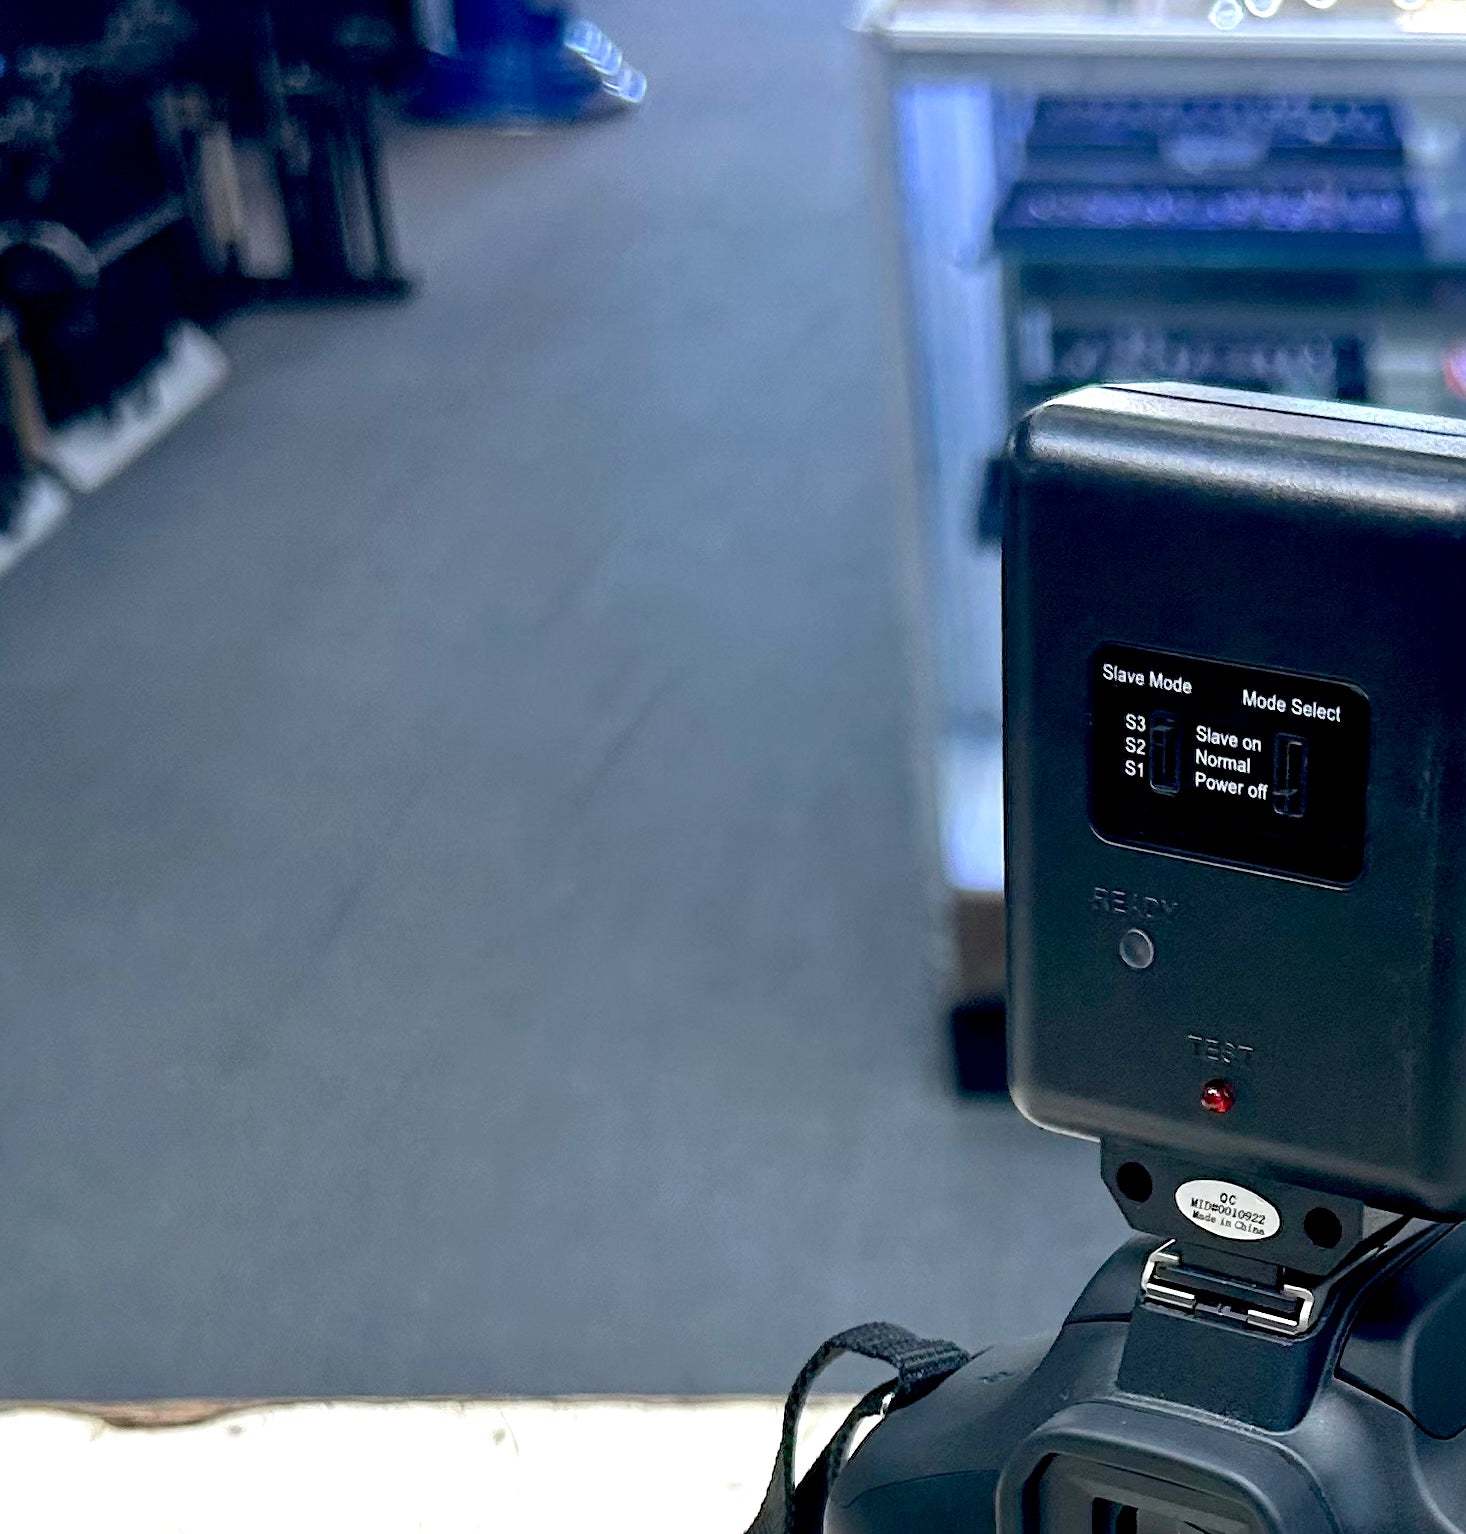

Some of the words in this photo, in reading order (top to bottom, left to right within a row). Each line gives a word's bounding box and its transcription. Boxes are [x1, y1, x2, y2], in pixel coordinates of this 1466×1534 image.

[1102, 663, 1145, 686] Slave
[1149, 671, 1193, 694] Mode
[1242, 689, 1287, 713] Mode
[1291, 698, 1341, 723] Select
[1125, 713, 1147, 732] S3
[1125, 737, 1147, 756] S2
[1195, 725, 1238, 749] Slave
[1242, 737, 1262, 752] on
[1125, 760, 1144, 778] S1
[1195, 749, 1251, 774] Normal
[1195, 772, 1244, 796] Power
[1247, 783, 1269, 801] off
[1187, 1034, 1254, 1067] TEST
[1192, 1209, 1217, 1224] Made
[1220, 1216, 1232, 1228] in
[1234, 1220, 1265, 1236] China
